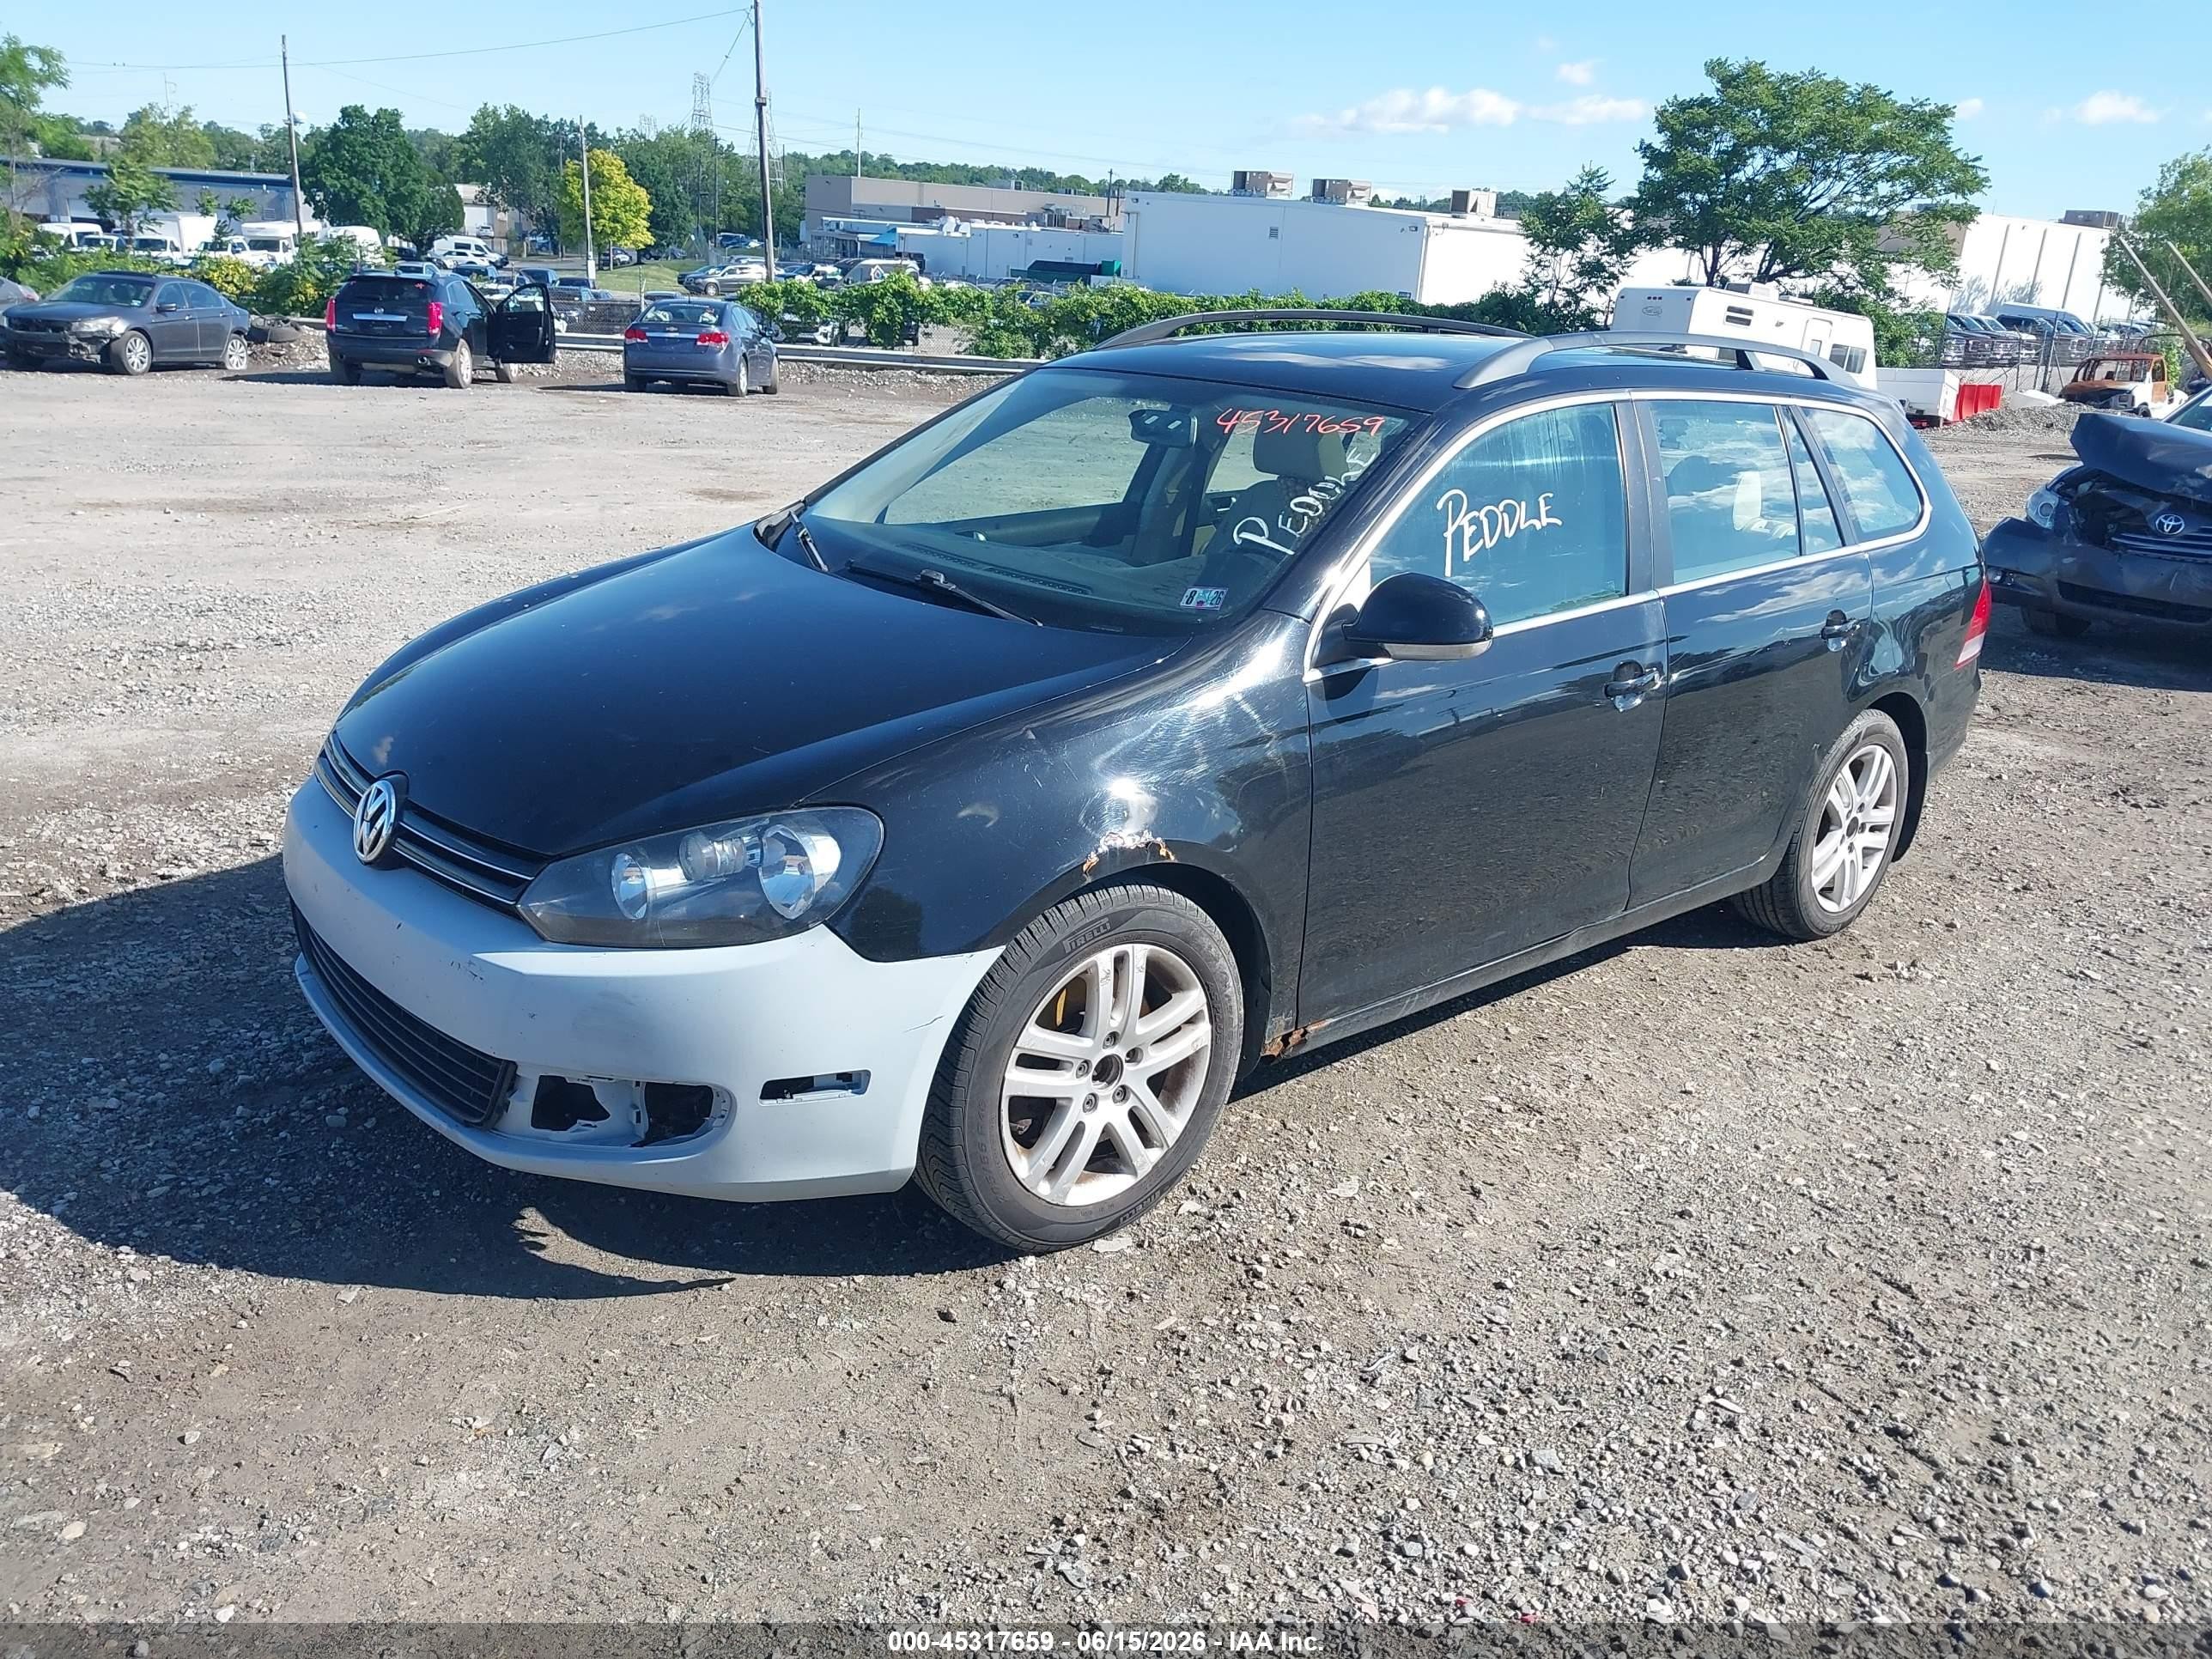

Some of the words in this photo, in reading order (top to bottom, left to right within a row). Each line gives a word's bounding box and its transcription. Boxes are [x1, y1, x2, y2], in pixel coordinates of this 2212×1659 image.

[1216, 408, 1385, 435] 45317659
[1436, 489, 1564, 578] PEDDLE
[1186, 590, 1198, 605] 8
[1211, 591, 1224, 605] 26
[1062, 917, 1111, 954] PIRELLI
